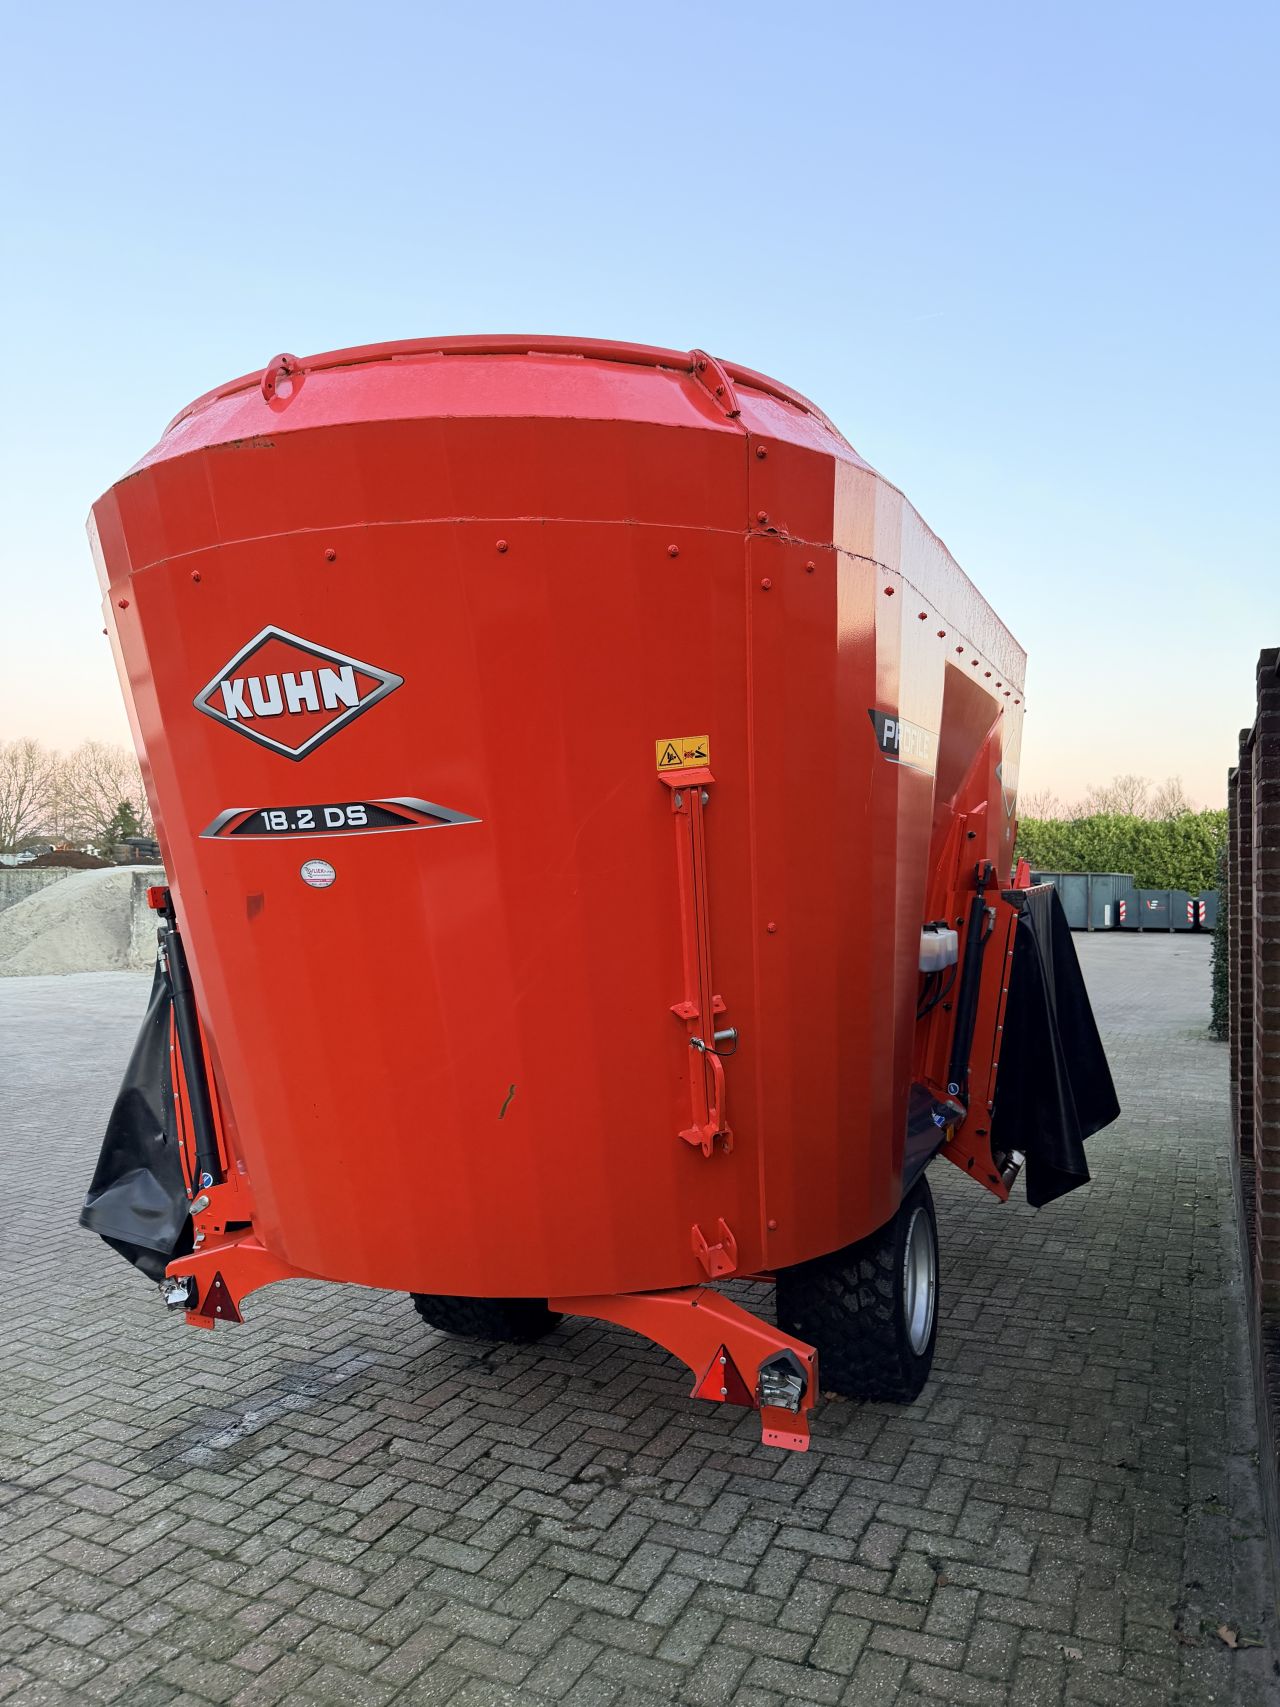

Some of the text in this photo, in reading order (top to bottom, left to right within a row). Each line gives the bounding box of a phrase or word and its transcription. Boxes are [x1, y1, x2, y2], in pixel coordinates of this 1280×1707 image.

[220, 665, 360, 720] KUHN
[261, 805, 368, 831] 18.2 DS
